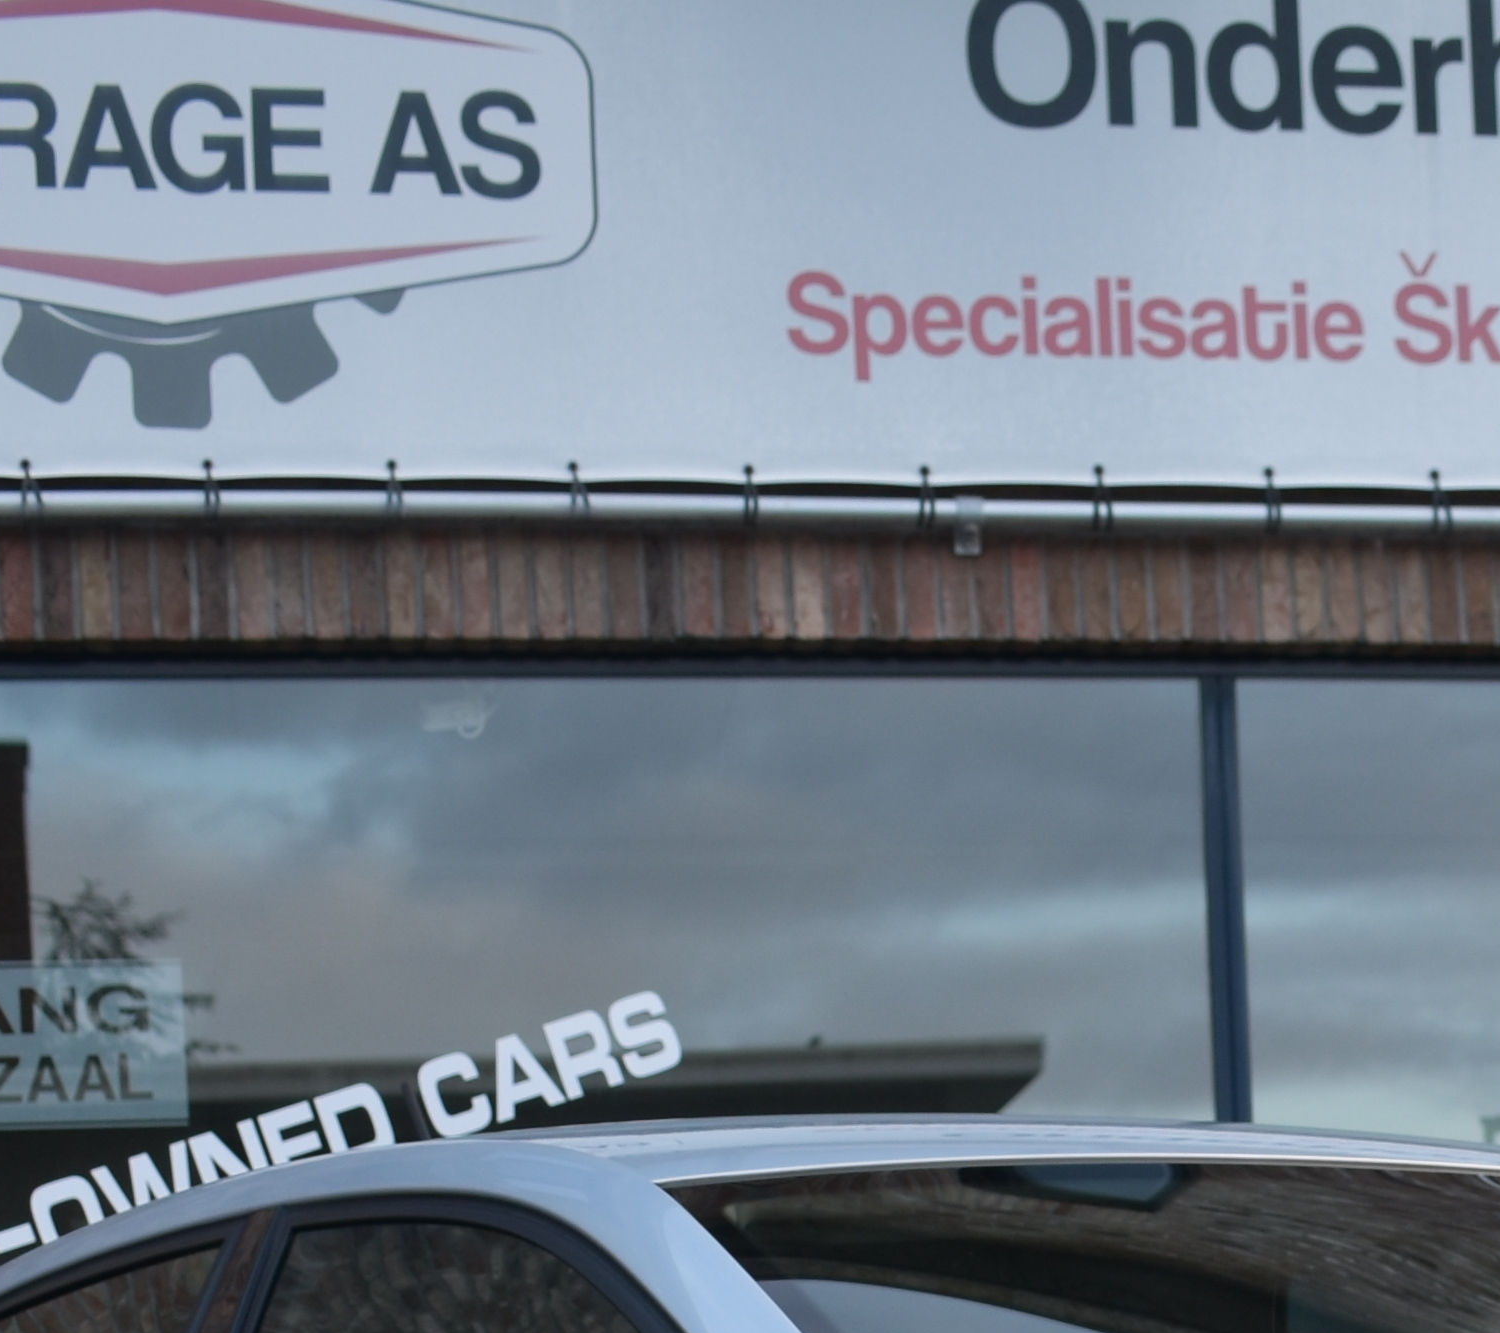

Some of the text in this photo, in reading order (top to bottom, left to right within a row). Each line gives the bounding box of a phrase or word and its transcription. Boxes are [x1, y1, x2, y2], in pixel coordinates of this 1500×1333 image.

[369, 89, 542, 200] AS
[785, 270, 1365, 383] Specialisatie
[416, 990, 684, 1139] CARS
